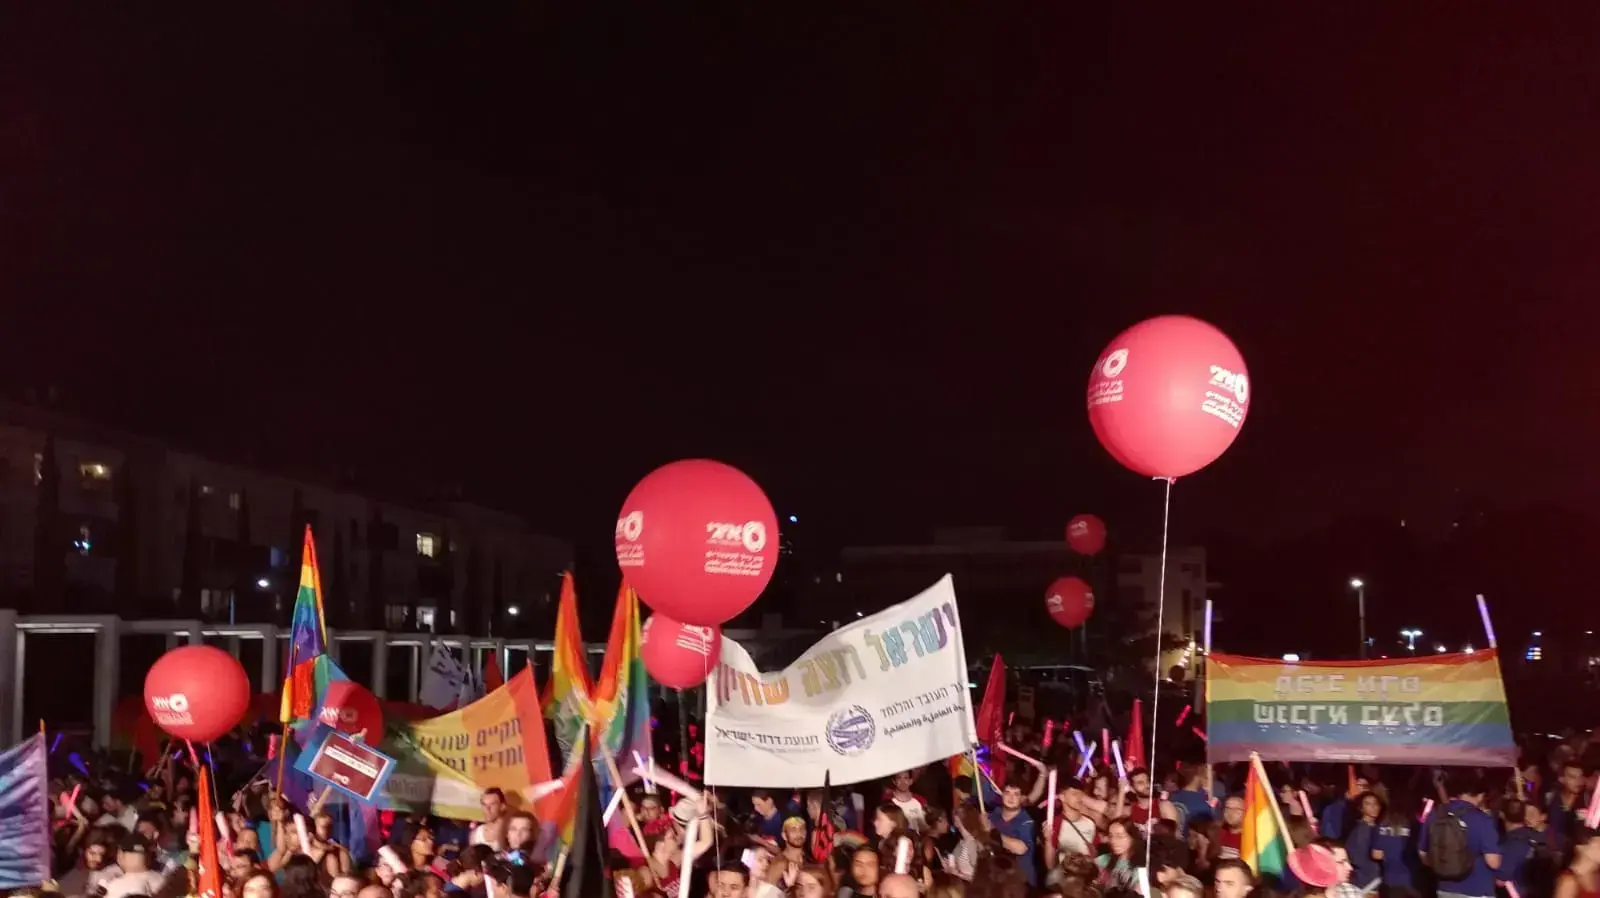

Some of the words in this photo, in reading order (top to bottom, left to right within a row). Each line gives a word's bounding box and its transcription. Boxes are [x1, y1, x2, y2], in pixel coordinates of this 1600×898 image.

[863, 602, 956, 671] ישראל
[797, 644, 867, 697] רוצה
[916, 686, 949, 705] העובד
[880, 699, 914, 718] והלומד
[476, 718, 522, 746] תקיים
[784, 735, 819, 746] תנועת
[472, 746, 523, 770] ומדיני
